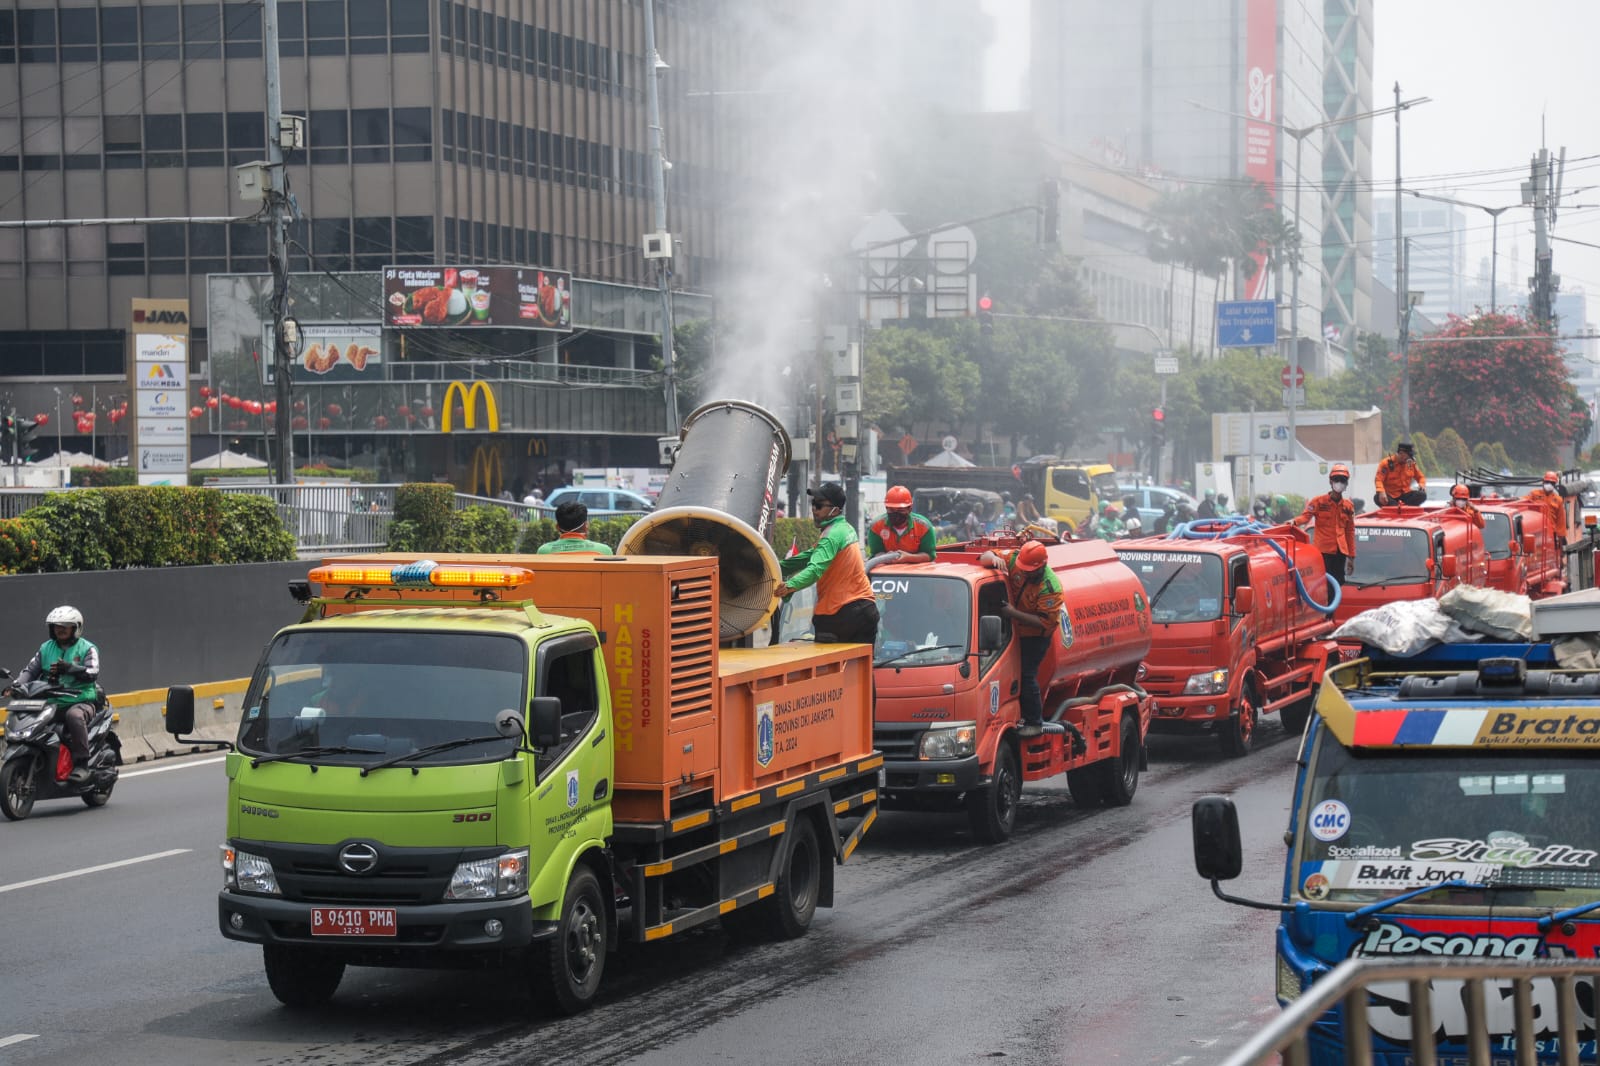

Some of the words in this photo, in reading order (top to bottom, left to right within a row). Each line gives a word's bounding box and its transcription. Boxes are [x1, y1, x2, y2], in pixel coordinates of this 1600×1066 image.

[146, 310, 188, 324] JAYA
[142, 349, 170, 357] mandiri
[1369, 528, 1381, 536] DKI
[1382, 528, 1412, 537] JAKARTA
[1152, 553, 1166, 562] DKI
[1168, 554, 1202, 564] JAKARTA
[614, 603, 633, 752] HARTECH
[641, 629, 651, 728] SOUNDPROOF
[775, 700, 792, 717] DINAS
[793, 690, 827, 712] LINGKUNGAN
[827, 687, 843, 703] HIDUP
[775, 717, 800, 735] PROVINSI
[800, 714, 809, 728] DKI
[811, 707, 835, 725] JAKARTA
[1479, 736, 1510, 744] Bukit
[1513, 736, 1541, 745] Jaya
[1544, 736, 1580, 744] Motor
[242, 804, 280, 819] HINO
[453, 812, 492, 823] 300
[1314, 813, 1346, 828] CMC
[1328, 845, 1402, 857] Specialized
[1409, 838, 1598, 868] Shaqila
[1357, 865, 1414, 881] Bukit
[1417, 866, 1465, 883] Jaya
[313, 910, 323, 926] B
[328, 910, 362, 927] 9610
[368, 910, 394, 927] PMA
